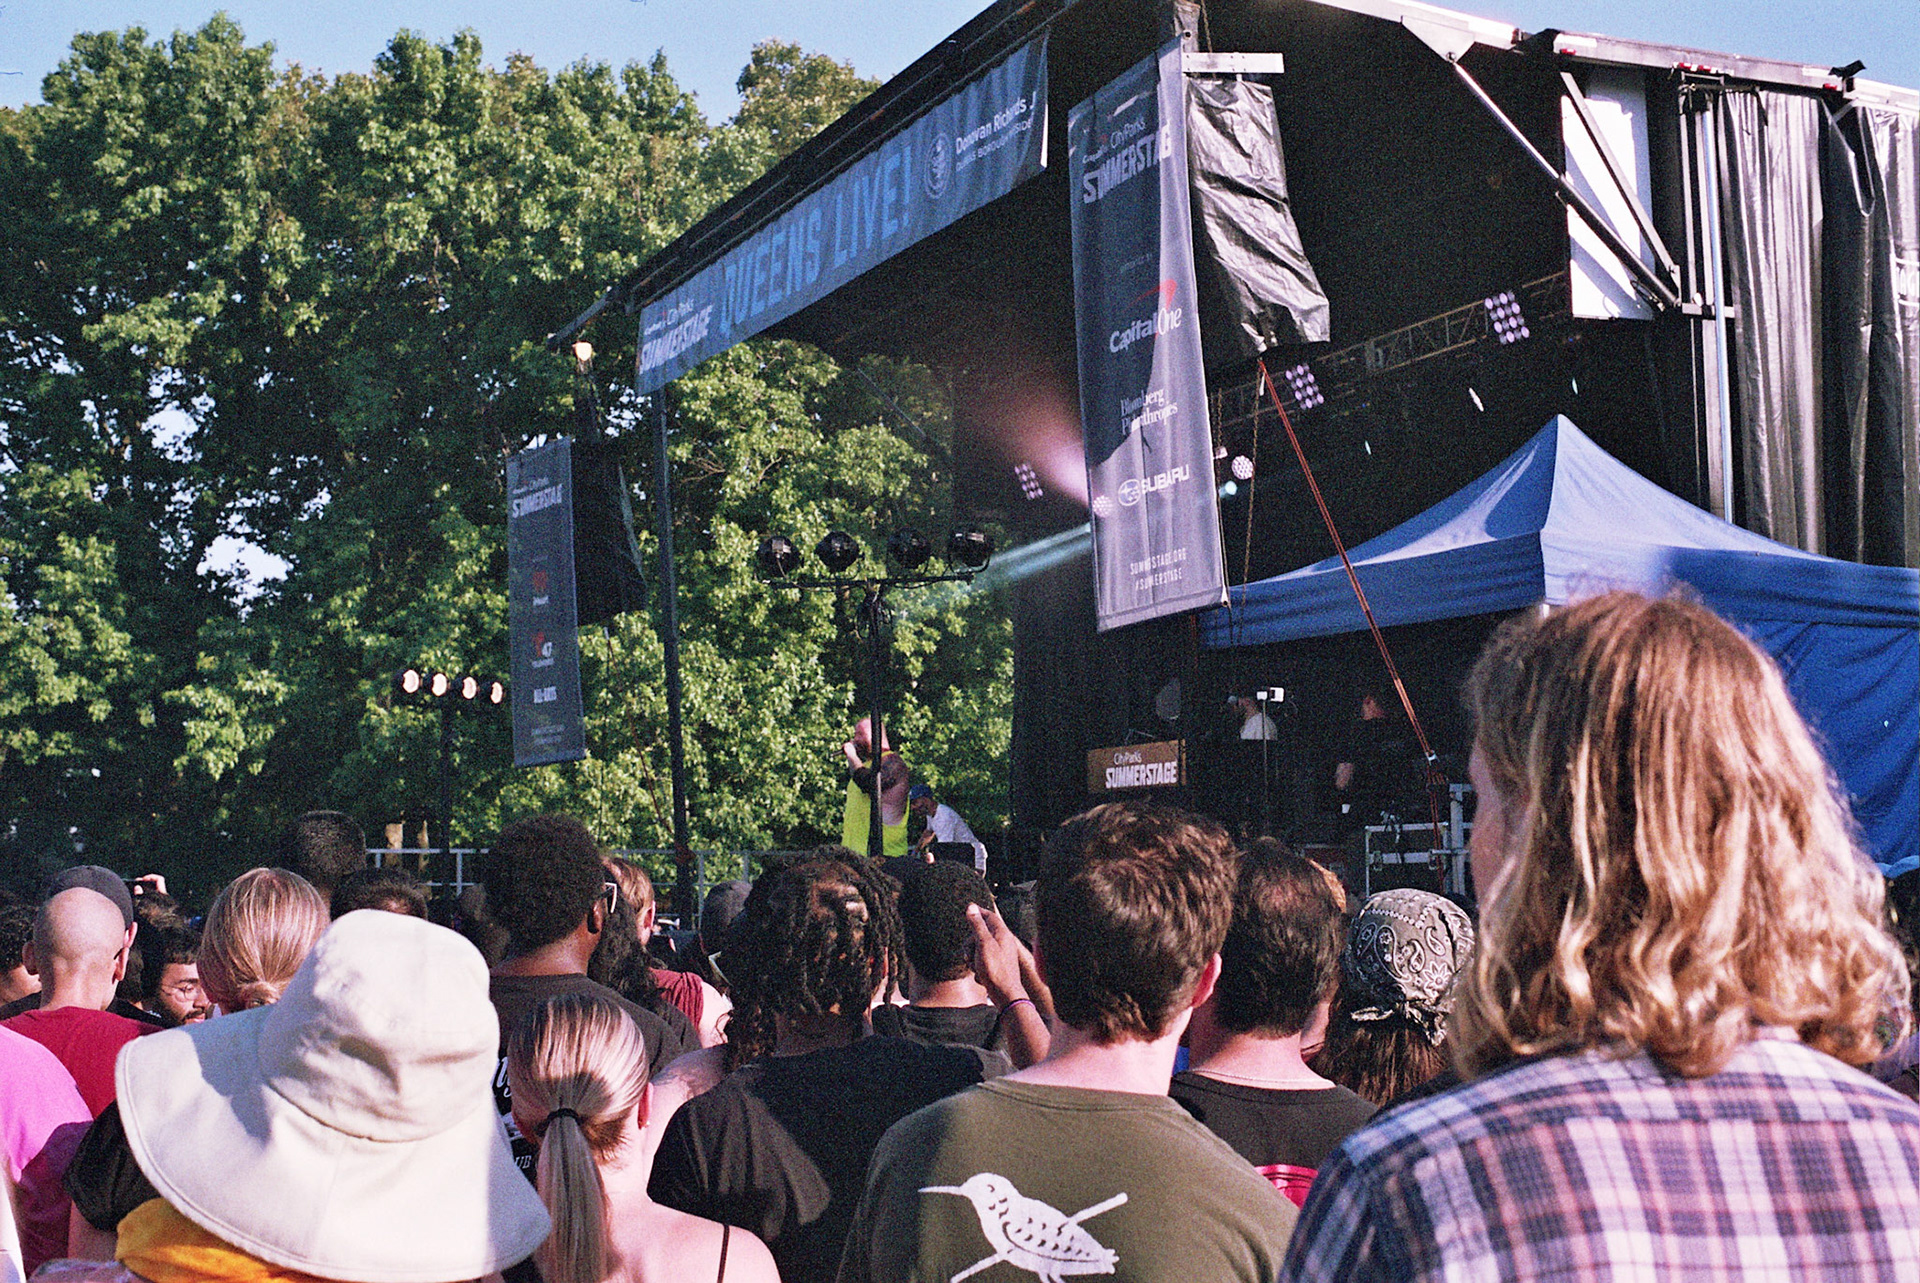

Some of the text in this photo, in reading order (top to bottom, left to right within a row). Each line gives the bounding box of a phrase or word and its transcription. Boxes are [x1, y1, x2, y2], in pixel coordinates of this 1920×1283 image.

[719, 146, 912, 339] QUEENS LIVE!
[1141, 464, 1190, 494] SUBARU
[1130, 547, 1186, 575] SUMMSTAGE.ORG
[1135, 567, 1182, 590] #SUMERSTAGE
[1105, 759, 1178, 788] SUMMERSTAGE
